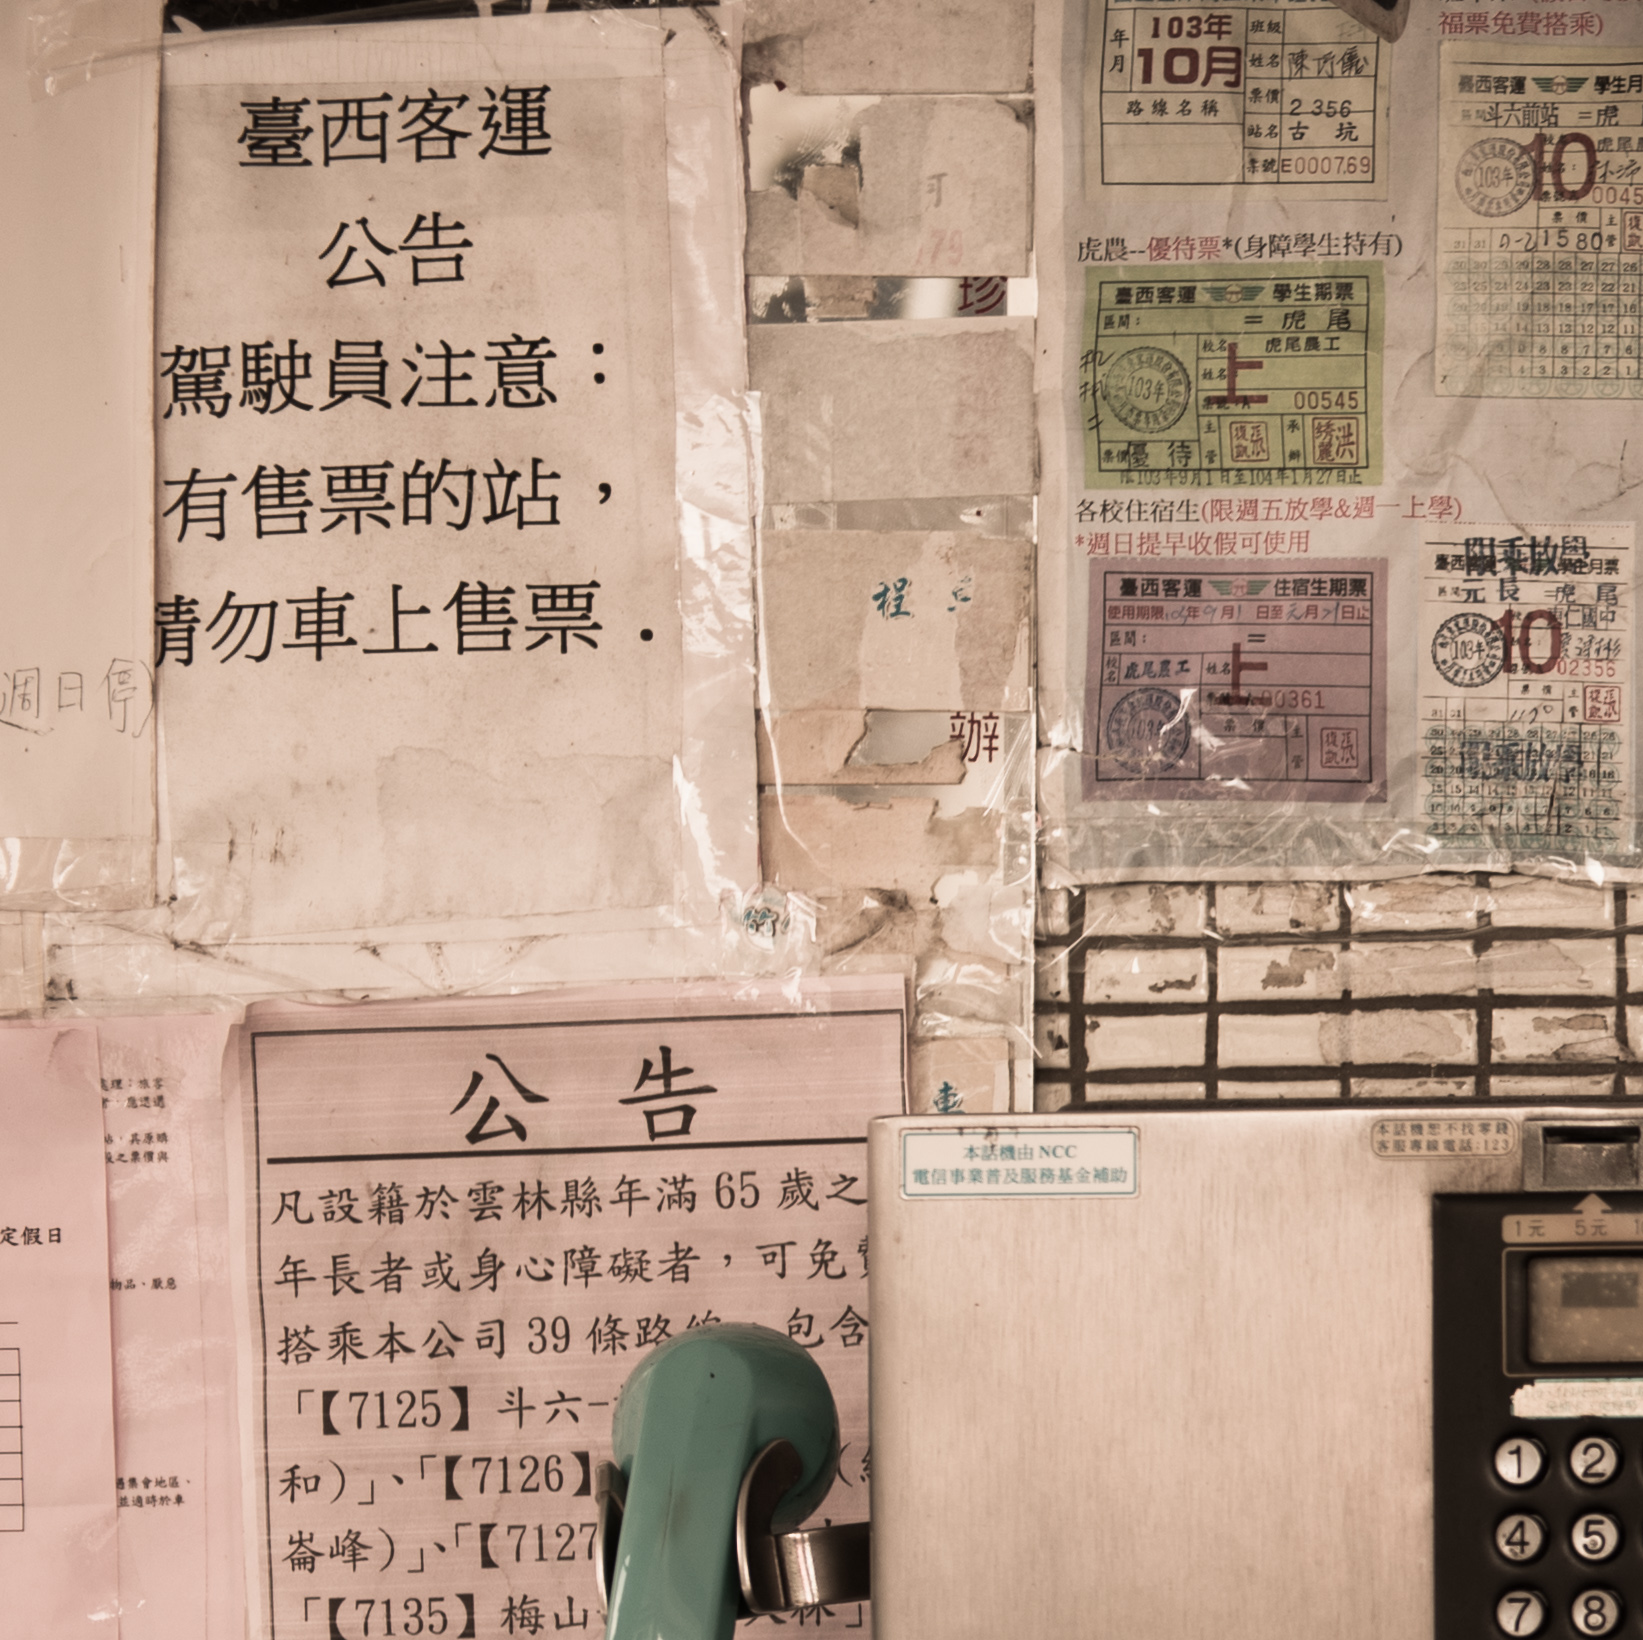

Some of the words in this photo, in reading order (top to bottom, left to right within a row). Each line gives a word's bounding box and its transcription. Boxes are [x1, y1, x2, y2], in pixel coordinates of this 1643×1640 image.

[1151, 14, 1232, 41] 103年
[1137, 46, 1241, 88] 10月
[1249, 51, 1280, 69] 姓名
[237, 83, 553, 168] 臺西客運
[1288, 120, 1358, 142] 古坑
[1519, 132, 1598, 201] 10
[318, 212, 474, 290] 公告
[161, 333, 607, 420] 駕駛員注意：
[1293, 390, 1360, 411] 00545
[162, 457, 613, 543] 有售票的站，
[1273, 577, 1368, 598] 住宿生期票
[449, 1045, 719, 1147] 公告
[1038, 1144, 1078, 1160] NCC
[273, 1234, 870, 1299] 年長者或身心障礙者，可免
[298, 1385, 622, 1436] 「【7125】斗六-
[1507, 1445, 1522, 1479] 1
[1581, 1442, 1607, 1479] 2
[1504, 1520, 1530, 1555] 4
[1582, 1519, 1606, 1555] 5
[1506, 1597, 1532, 1633] 7
[1583, 1595, 1607, 1632] 8
